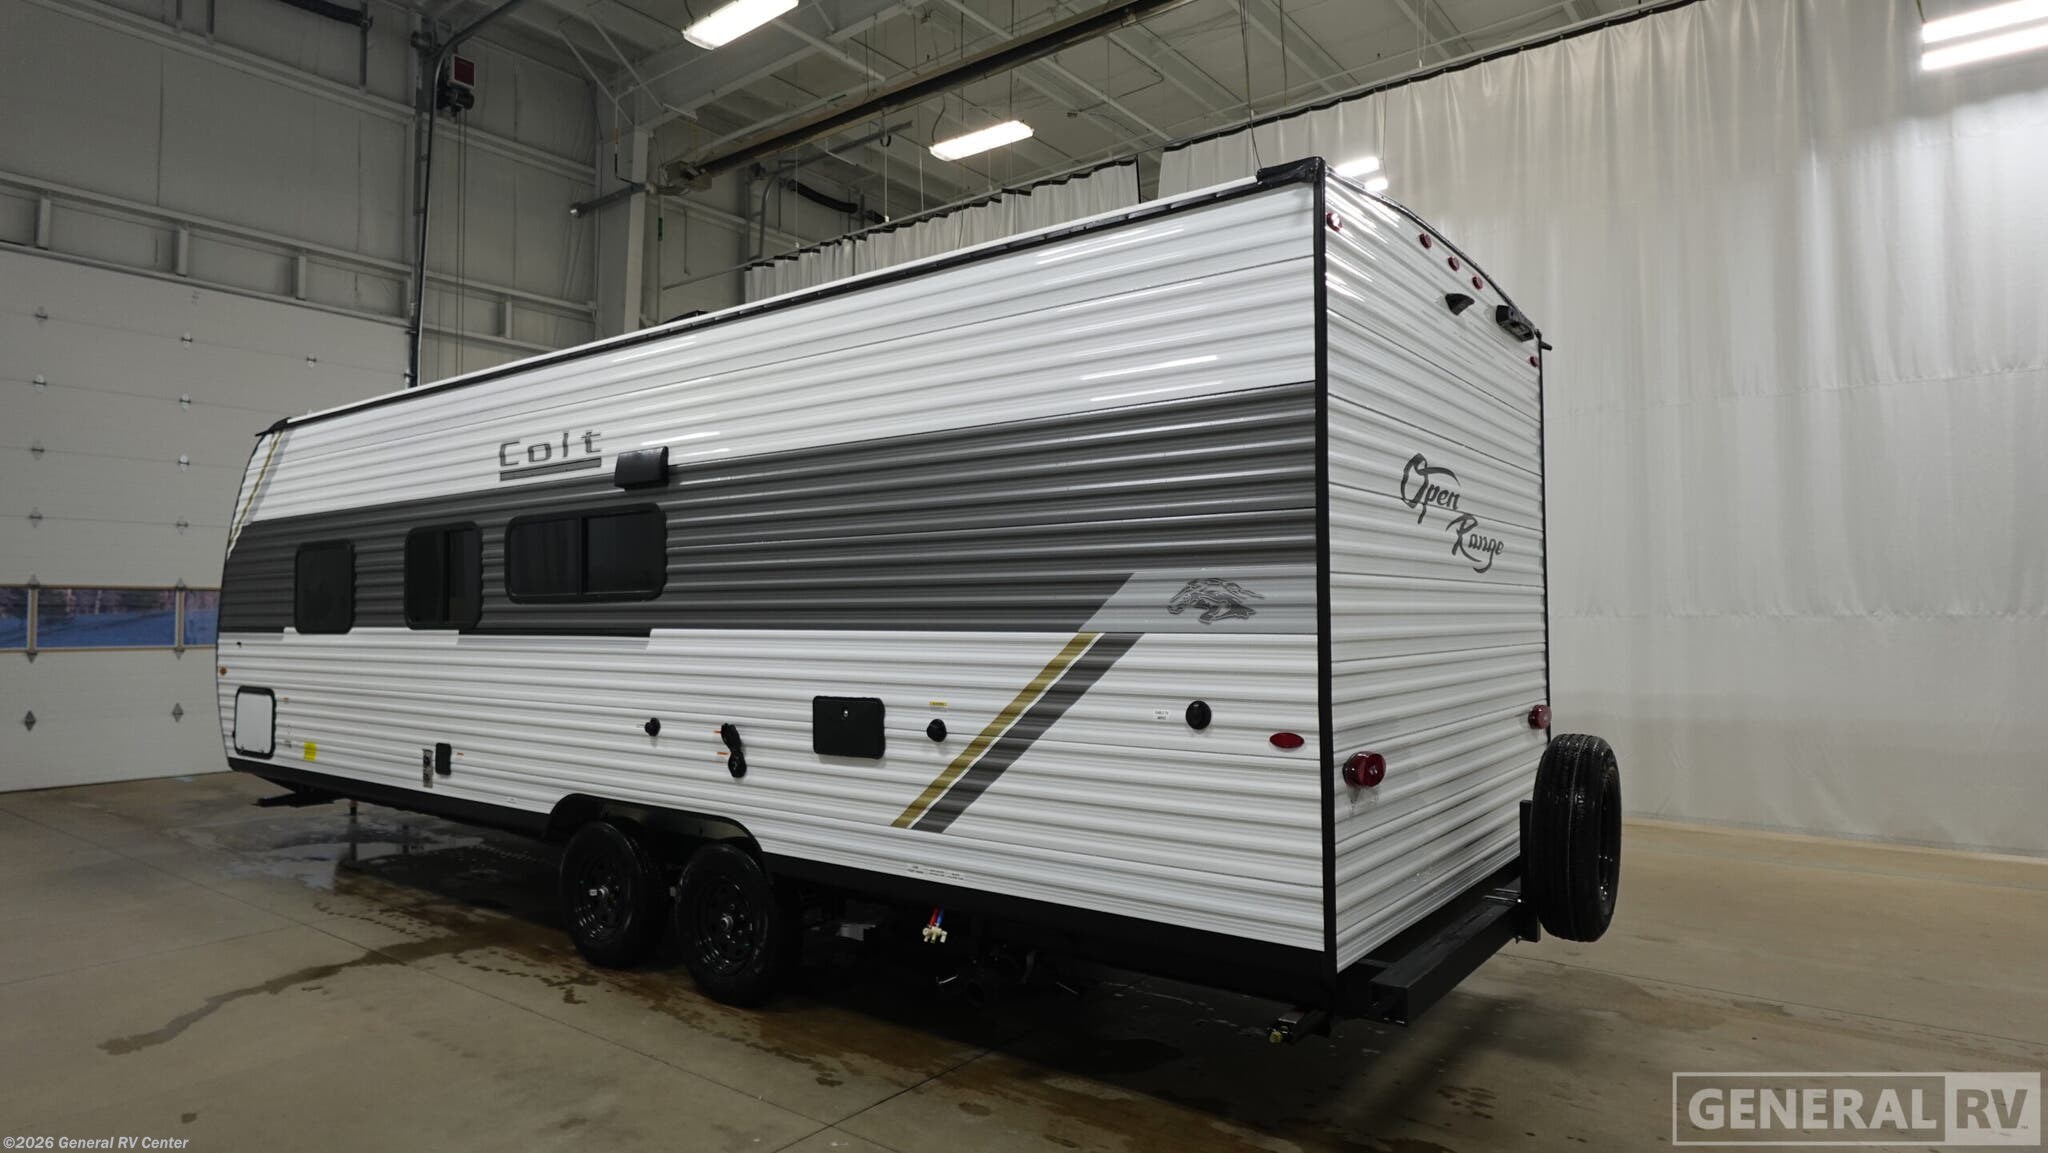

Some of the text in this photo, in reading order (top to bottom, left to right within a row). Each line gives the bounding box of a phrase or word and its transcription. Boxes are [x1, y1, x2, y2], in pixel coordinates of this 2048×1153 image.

[499, 430, 602, 467] Colt
[1401, 453, 1461, 524] Open
[1445, 513, 1504, 574] Range
